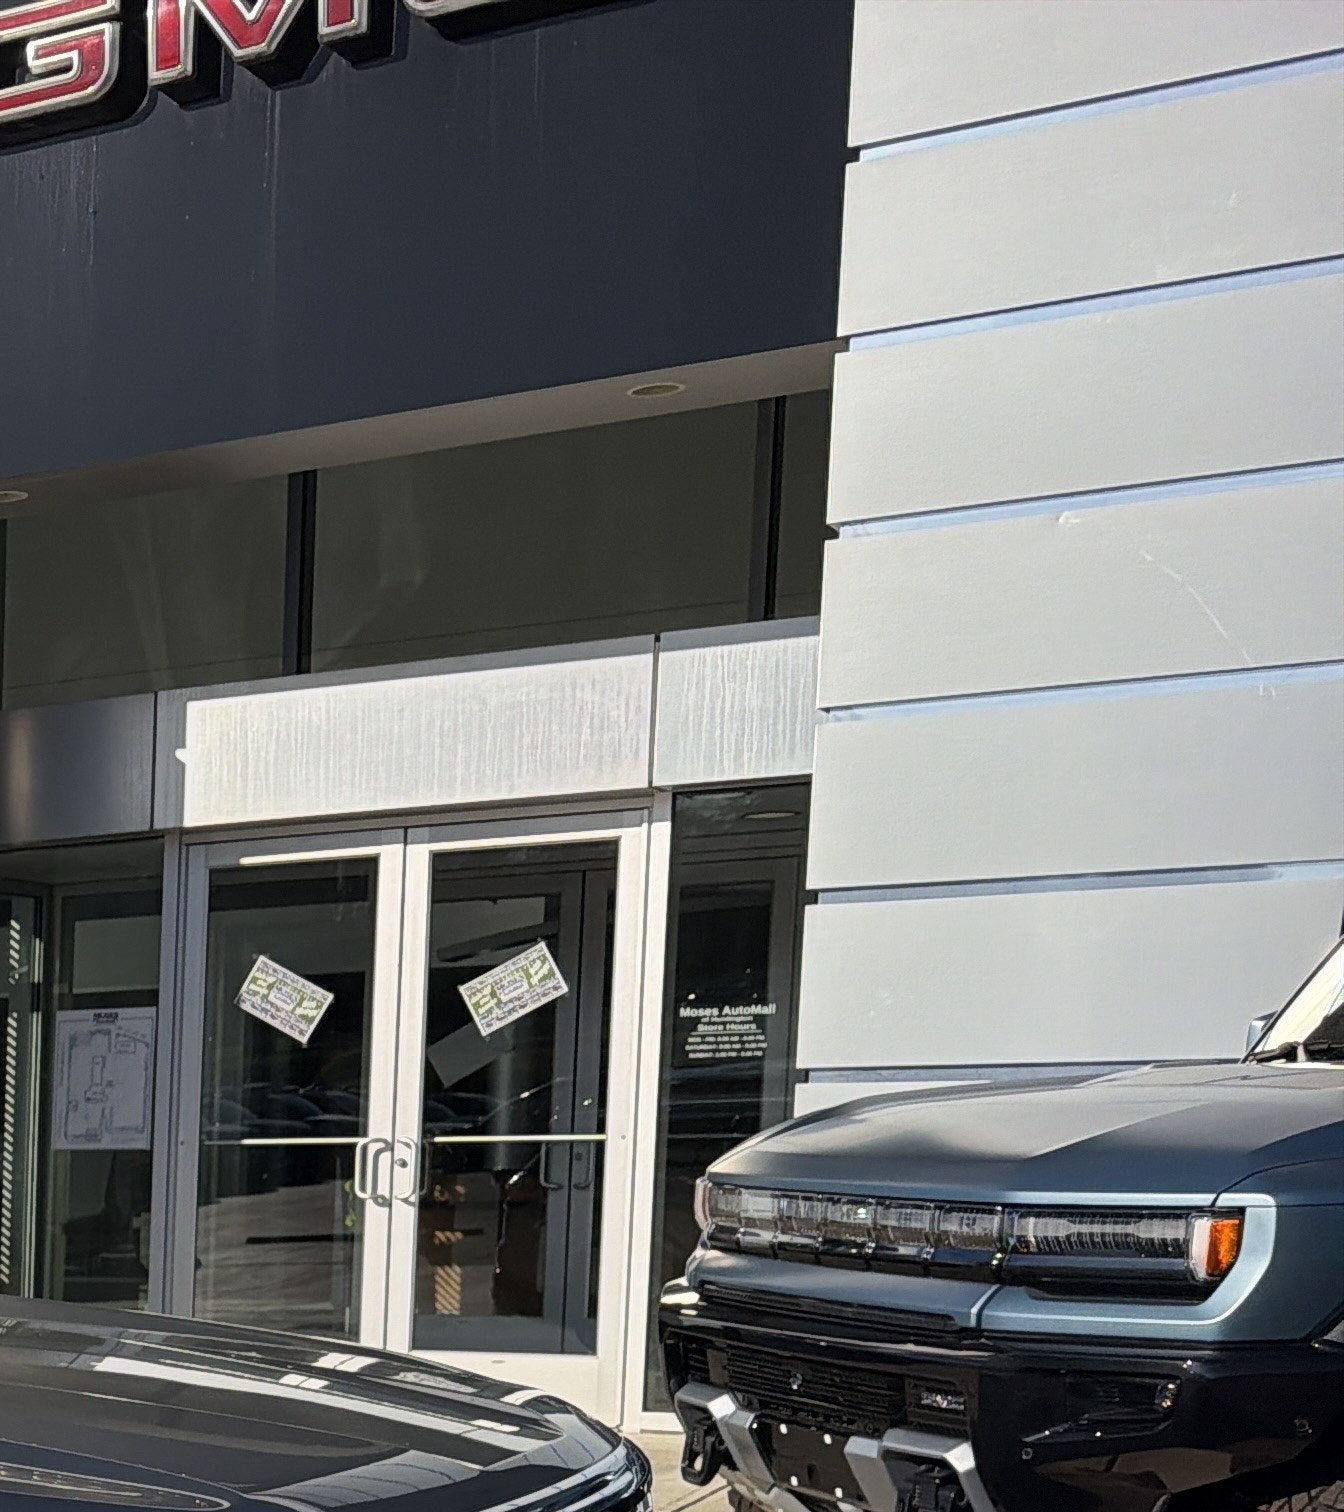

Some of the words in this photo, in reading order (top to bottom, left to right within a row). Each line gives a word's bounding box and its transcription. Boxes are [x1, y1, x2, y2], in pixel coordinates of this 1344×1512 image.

[679, 1007, 719, 1018] Moses
[722, 1003, 776, 1016] AutoMall
[697, 1023, 724, 1031] Store
[726, 1023, 756, 1031] Hours
